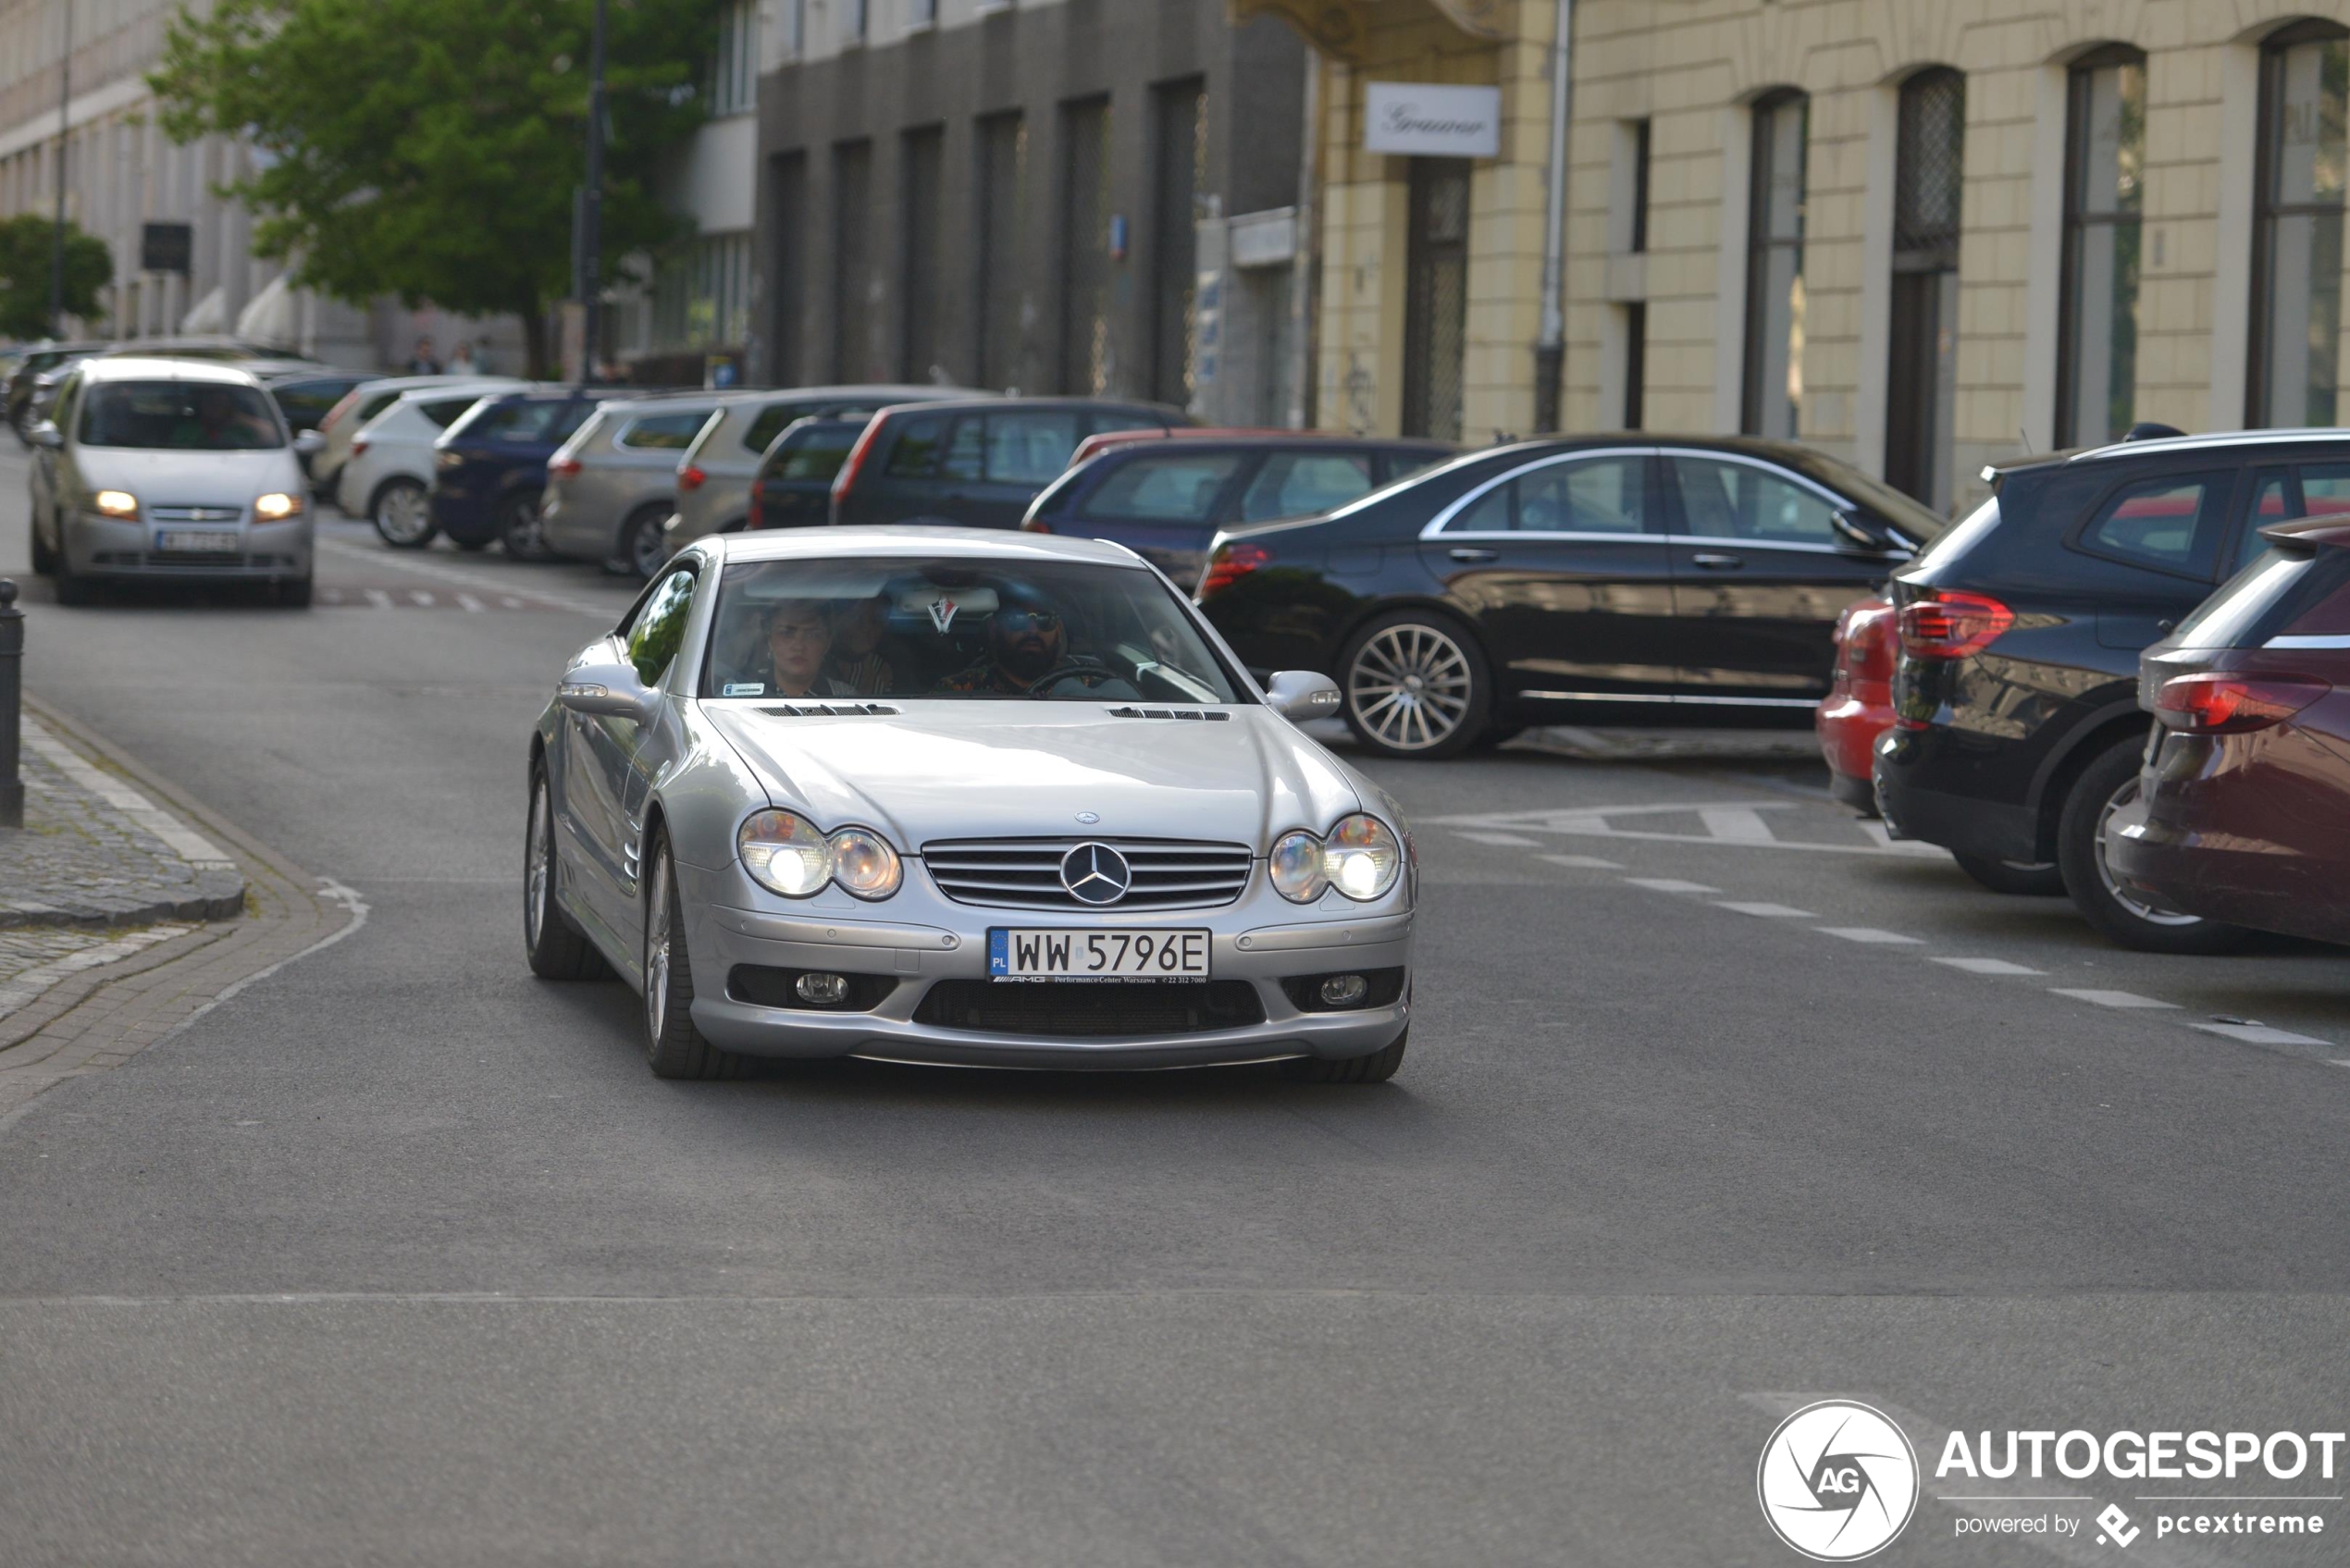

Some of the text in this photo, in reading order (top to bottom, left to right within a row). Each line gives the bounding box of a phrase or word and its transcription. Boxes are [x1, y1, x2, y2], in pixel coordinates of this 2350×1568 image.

[993, 958, 1007, 968] PL
[1016, 934, 1203, 971] WW 5796E
